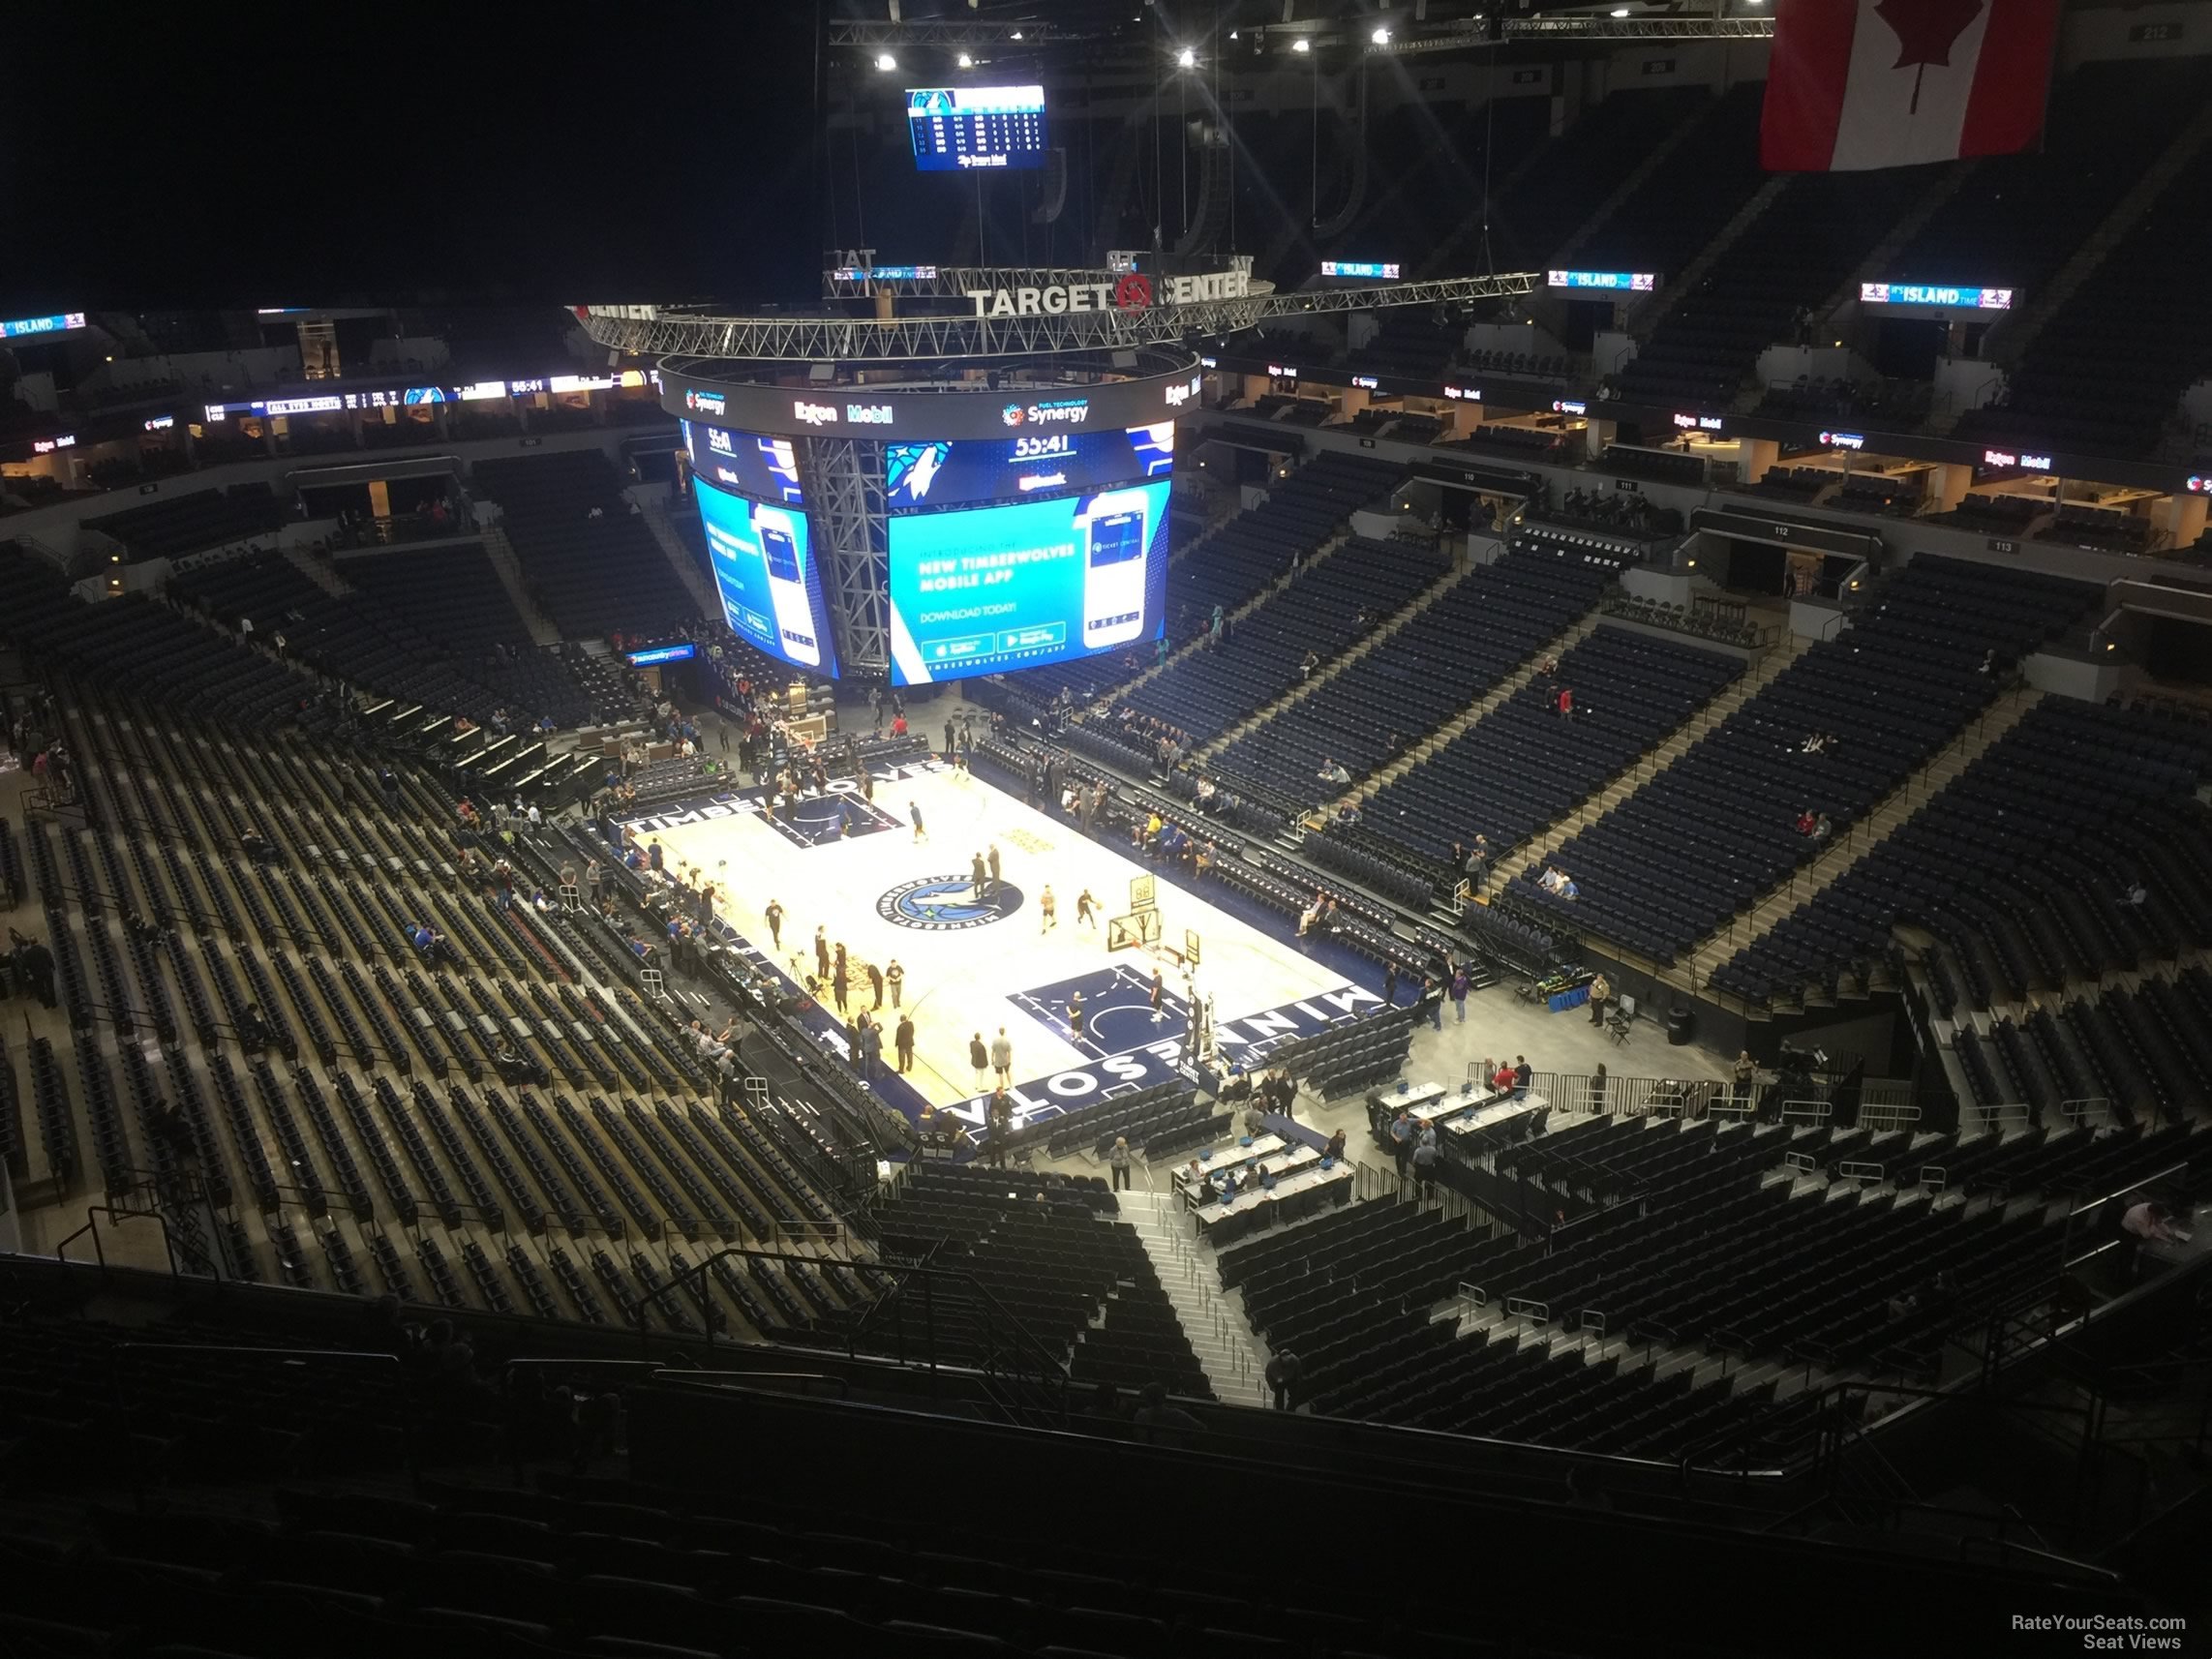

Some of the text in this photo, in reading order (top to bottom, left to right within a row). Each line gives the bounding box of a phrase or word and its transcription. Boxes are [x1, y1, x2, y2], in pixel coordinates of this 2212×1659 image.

[2143, 25, 2169, 40] 212
[1578, 272, 1618, 287] ISLAND
[967, 285, 1112, 318] TARGET
[1903, 287, 1959, 304] ISLAND
[15, 317, 54, 334] ISLAND
[694, 393, 726, 416] Synergy
[1038, 399, 1088, 409] FUEL TECHNOLOGY
[794, 402, 894, 426] Exxon Mobil
[1027, 406, 1089, 425] Synergy
[1015, 435, 1069, 457] 55:41
[1831, 435, 1864, 450] Synergy
[1985, 451, 2050, 469] Exxon Mobil
[1464, 472, 1474, 481] 110
[1775, 527, 1788, 536] 112
[1995, 542, 2013, 552] 113
[919, 543, 1076, 576] NEW TIMBERWOLVES
[920, 569, 1014, 592] MOBILE APP
[921, 602, 1017, 624] DOWNLOAD TODAY!
